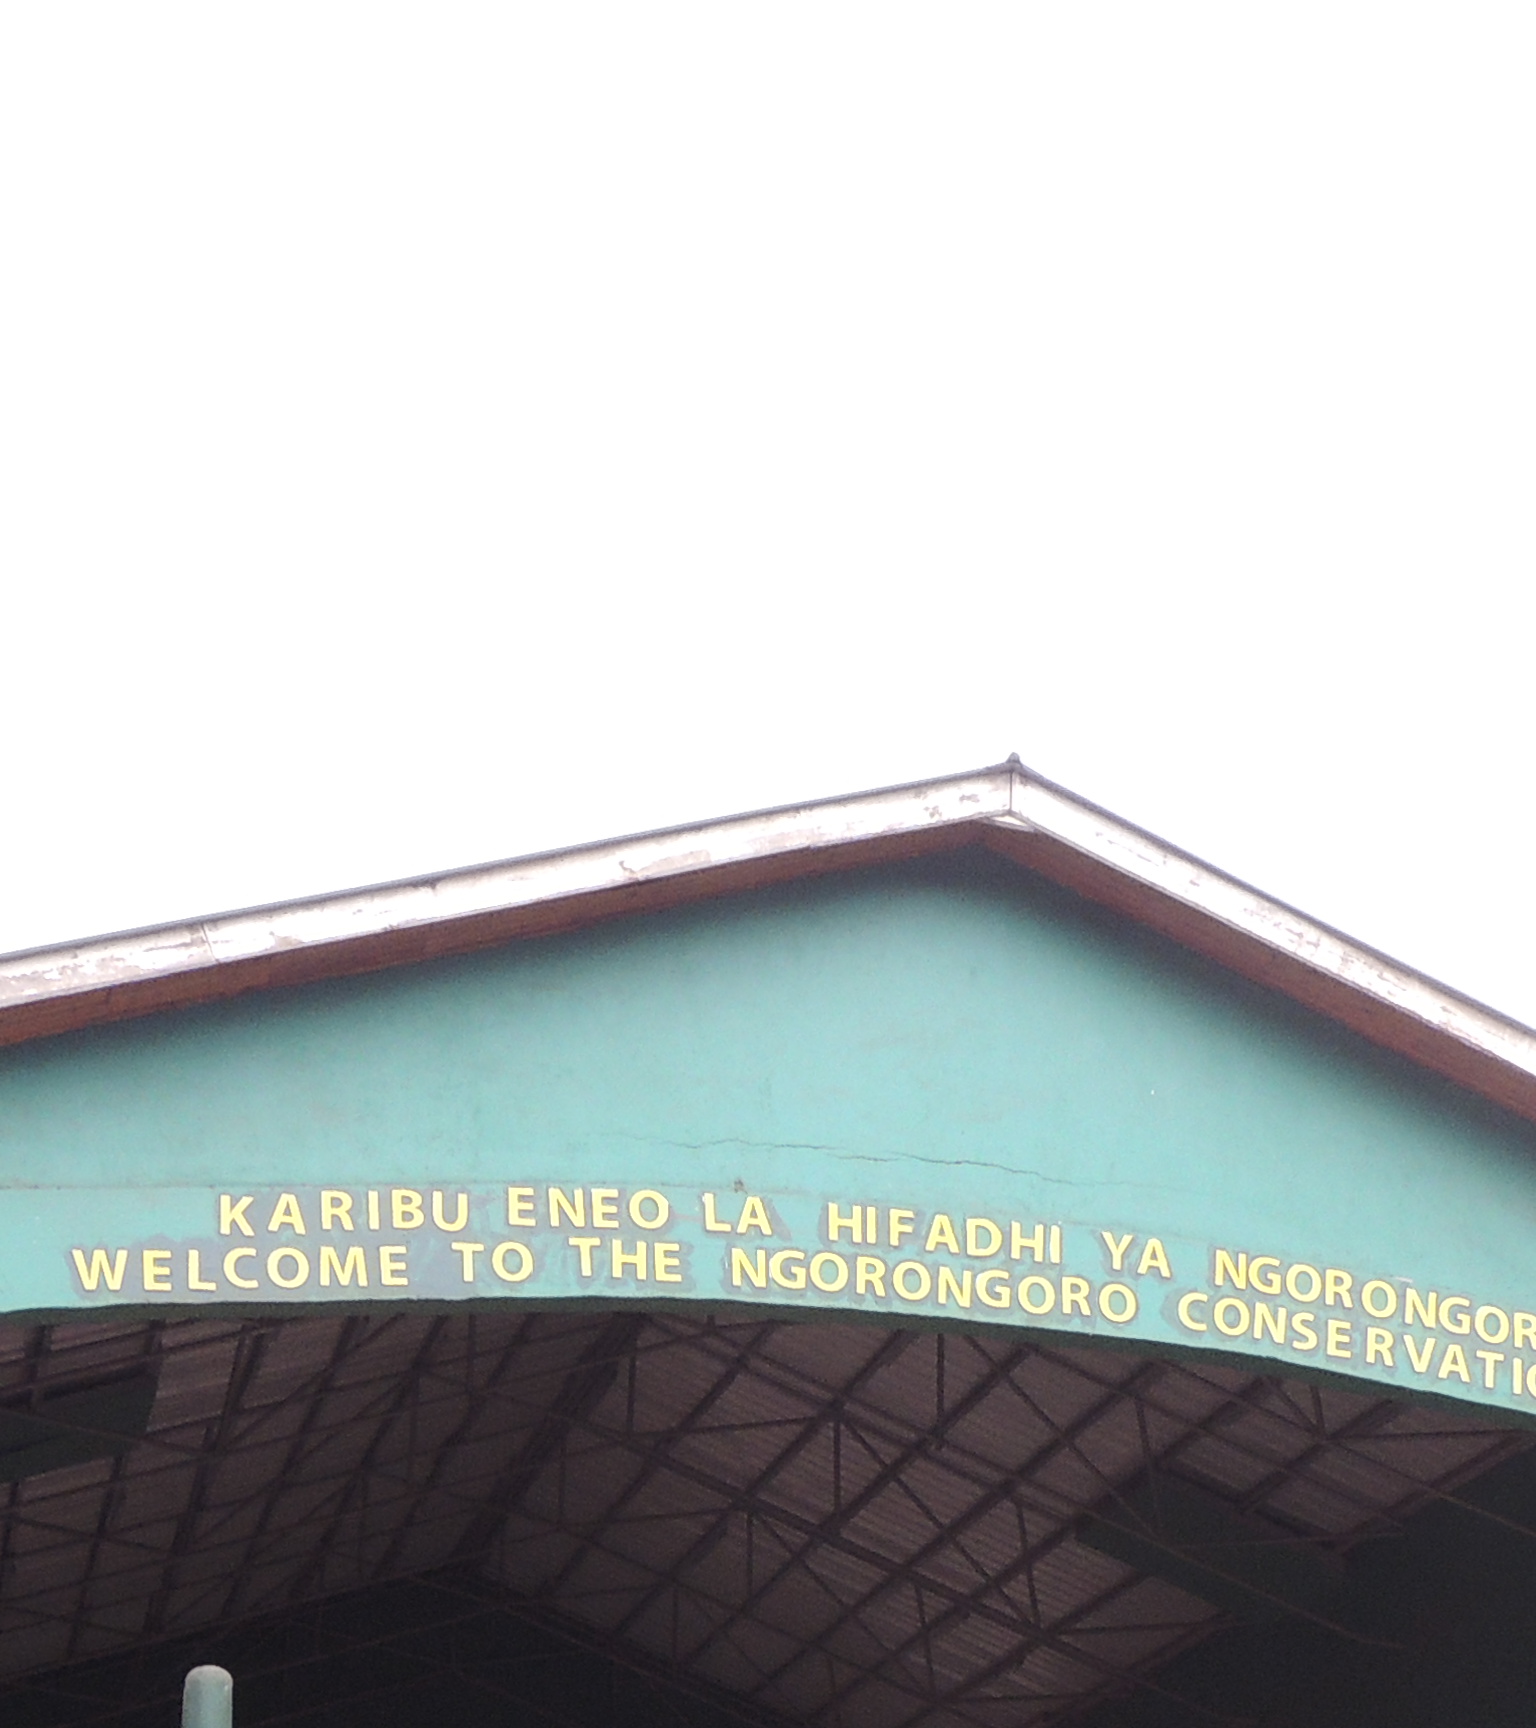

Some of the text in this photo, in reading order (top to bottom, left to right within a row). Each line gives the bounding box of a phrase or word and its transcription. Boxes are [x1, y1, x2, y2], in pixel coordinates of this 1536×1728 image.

[219, 1188, 469, 1237] KARIBU
[507, 1186, 669, 1230] ENEO
[702, 1192, 772, 1236] LA
[827, 1202, 1062, 1264] HIFADHI
[1101, 1230, 1172, 1278] YA
[71, 1245, 409, 1293] WELCOME
[451, 1241, 534, 1284] TO
[569, 1236, 682, 1283] THE
[731, 1247, 1137, 1324] NGORONGORO
